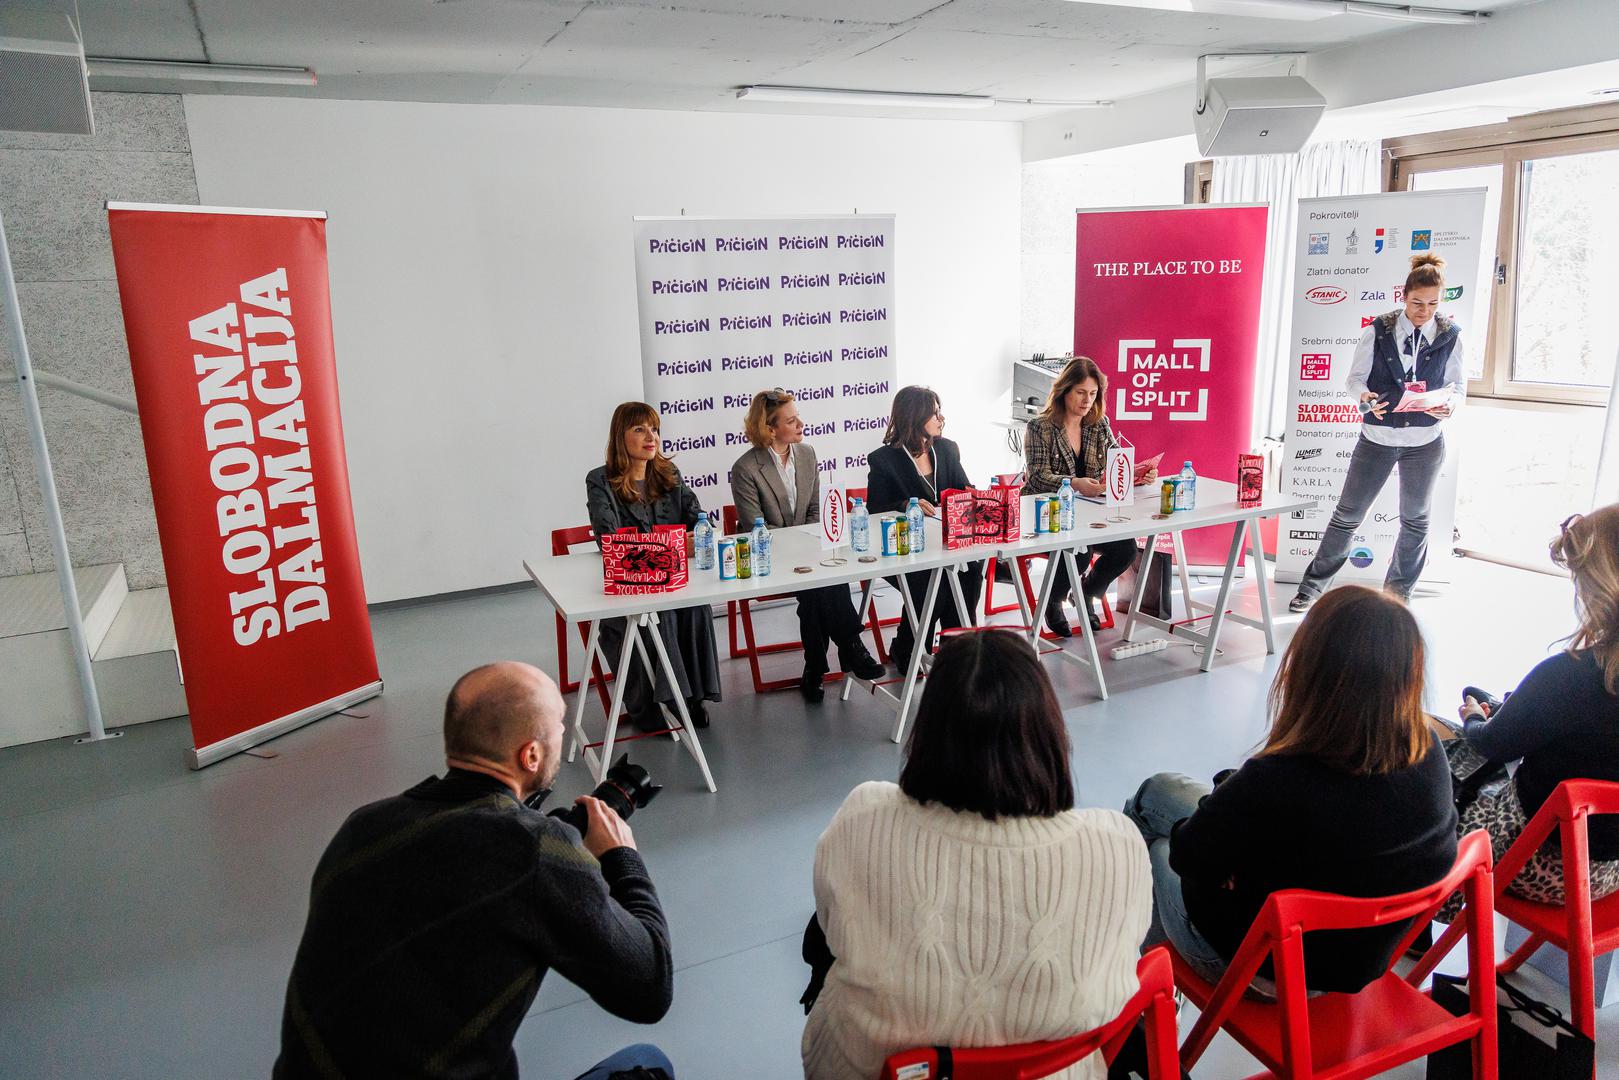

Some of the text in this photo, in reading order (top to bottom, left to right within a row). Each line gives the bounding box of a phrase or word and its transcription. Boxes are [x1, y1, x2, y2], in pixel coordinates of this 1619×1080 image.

[1309, 210, 1359, 221] Pokrovitelji
[1093, 259, 1242, 277] THE PLACE TO BE
[1306, 265, 1370, 277] Zlatni donator
[1360, 290, 1386, 301] Zala
[1301, 337, 1333, 346] Srebrni
[1133, 353, 1195, 370] MALL
[1132, 372, 1162, 388] OF
[1131, 390, 1191, 407] SPLIT
[1298, 389, 1334, 399] Medijski
[1297, 404, 1359, 414] SLOBODNA
[1297, 414, 1363, 423] DALMACIJA
[1296, 429, 1333, 438] Donatori
[239, 267, 331, 634] DALMACIJA
[1336, 450, 1351, 458] ele
[188, 302, 282, 647] SLOBODNA
[1292, 477, 1332, 487] KARLA
